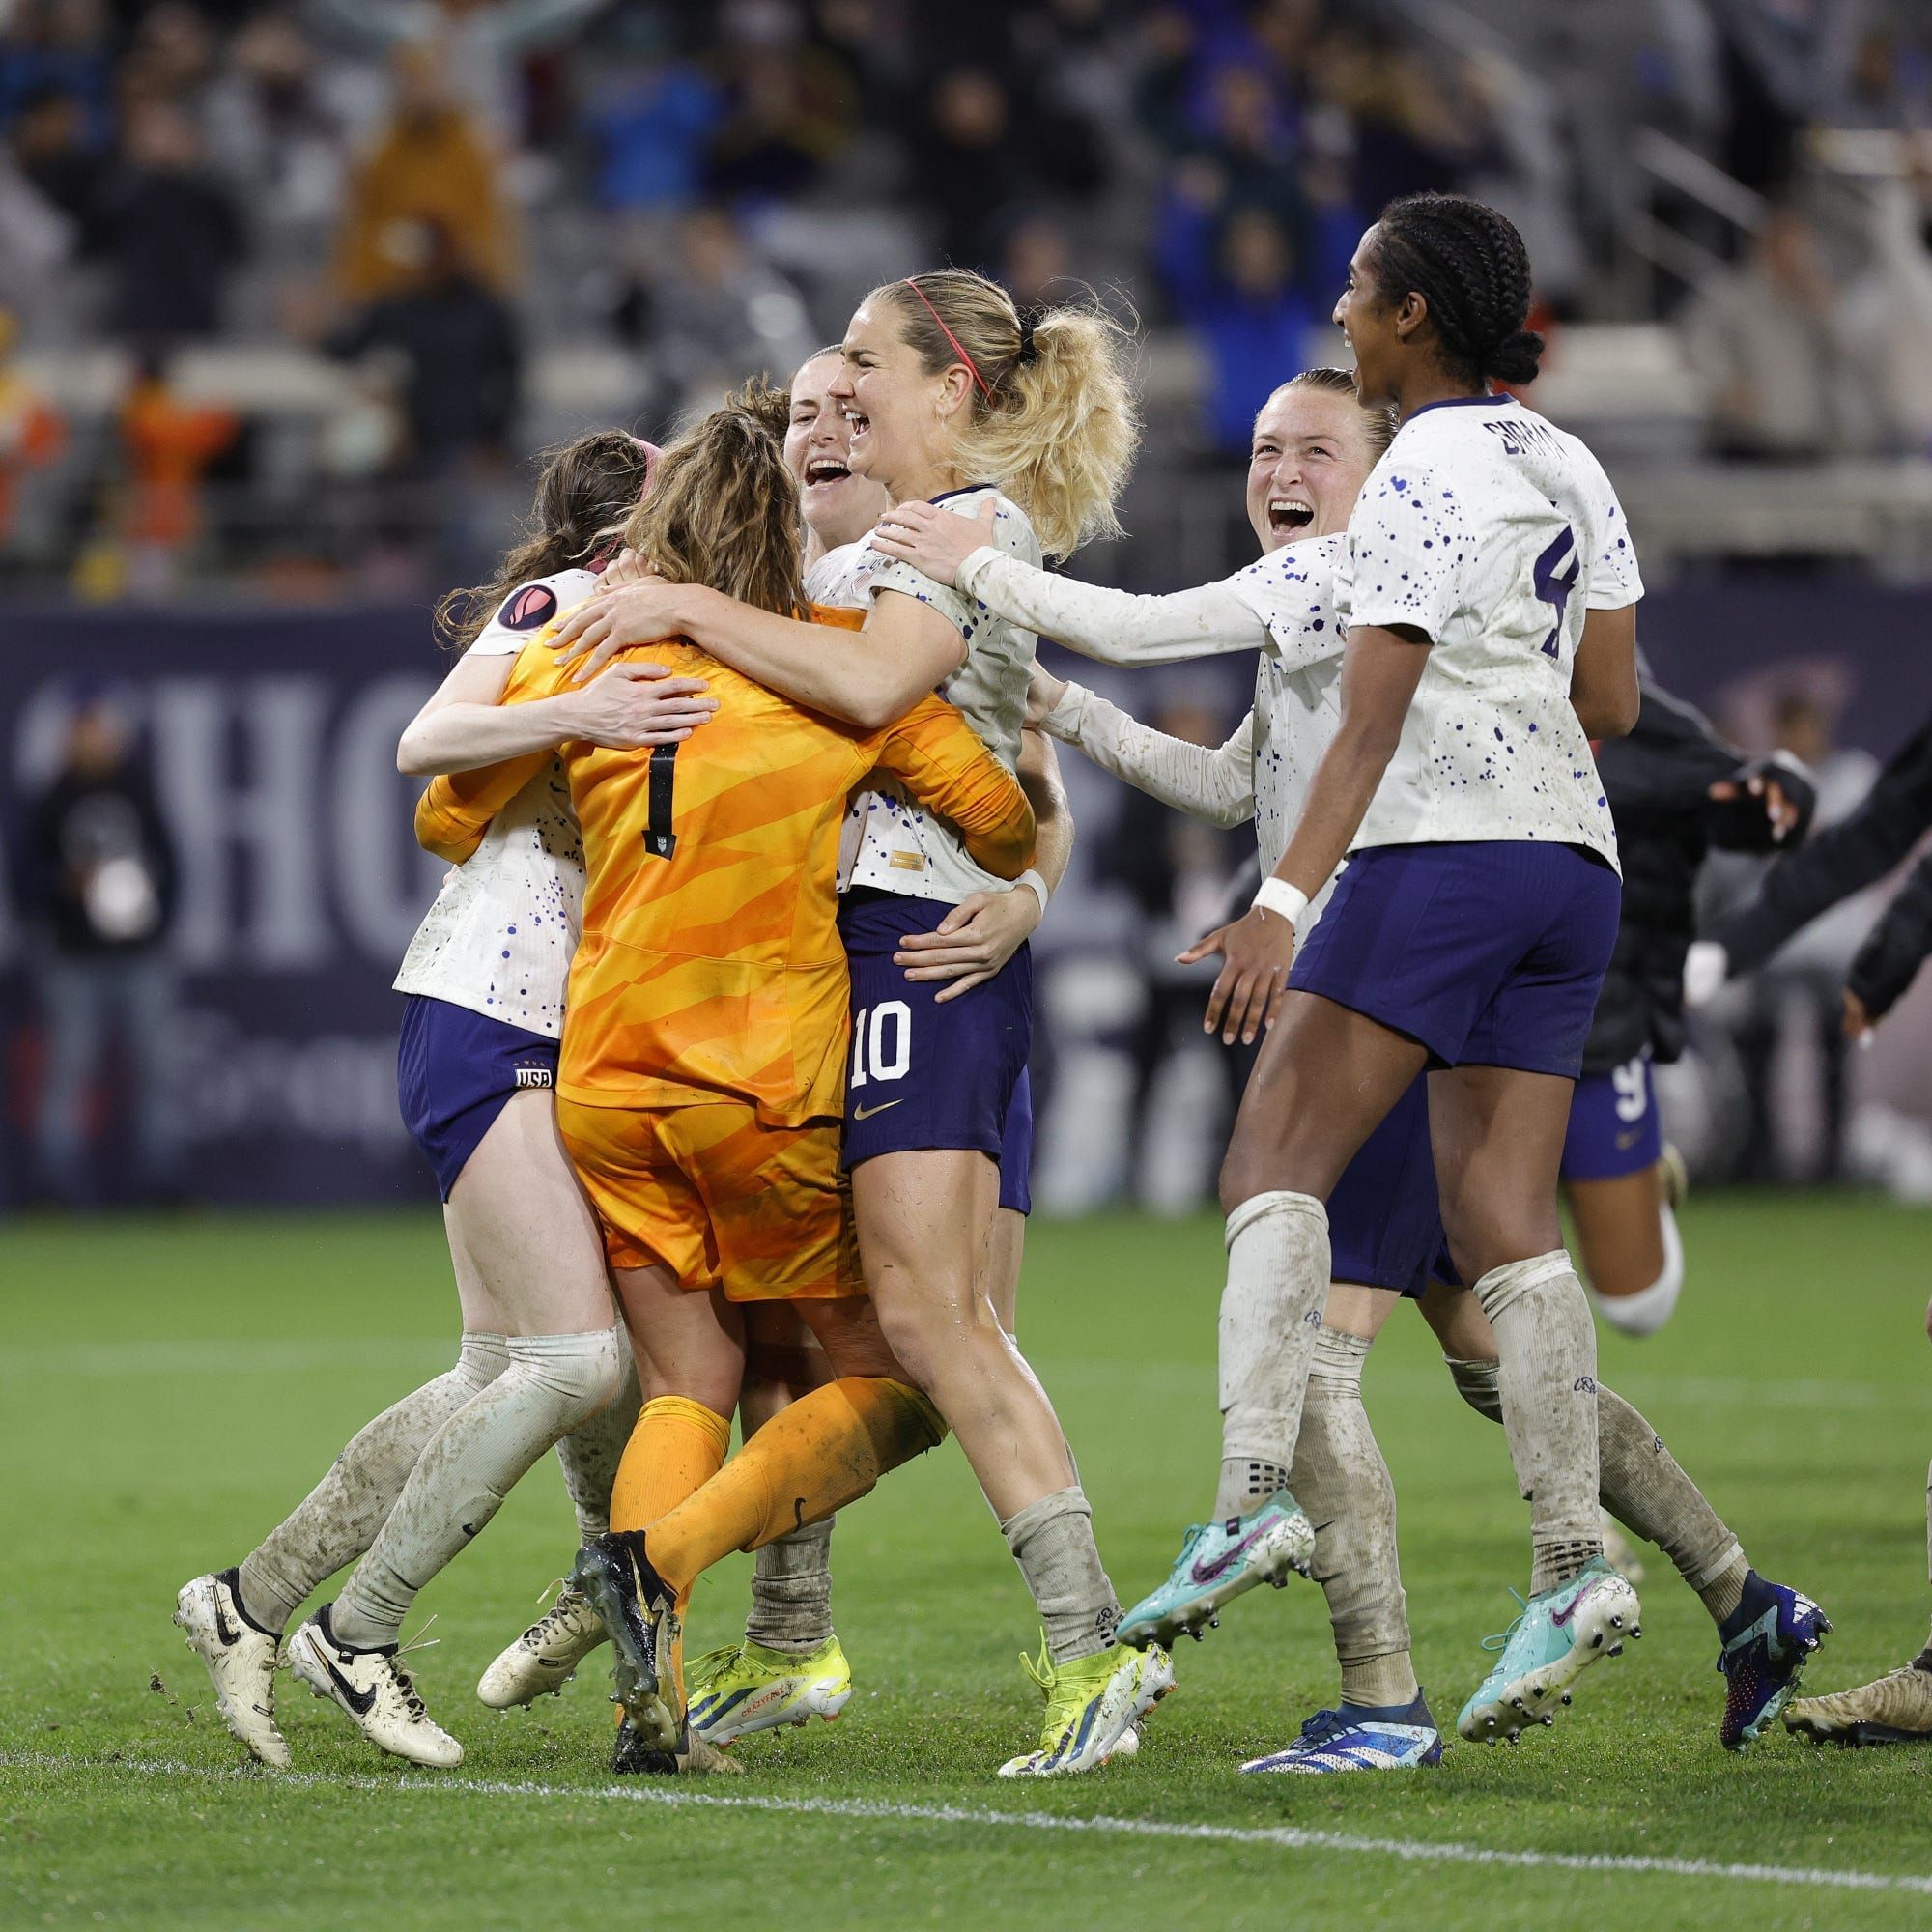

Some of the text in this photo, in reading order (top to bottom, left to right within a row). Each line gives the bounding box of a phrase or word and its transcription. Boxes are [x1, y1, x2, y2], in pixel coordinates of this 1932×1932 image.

[1533, 501, 1580, 659] 4
[640, 742, 679, 862] 1
[519, 1070, 551, 1088] USA
[850, 999, 912, 1090] 10
[1611, 1056, 1648, 1122] 9
